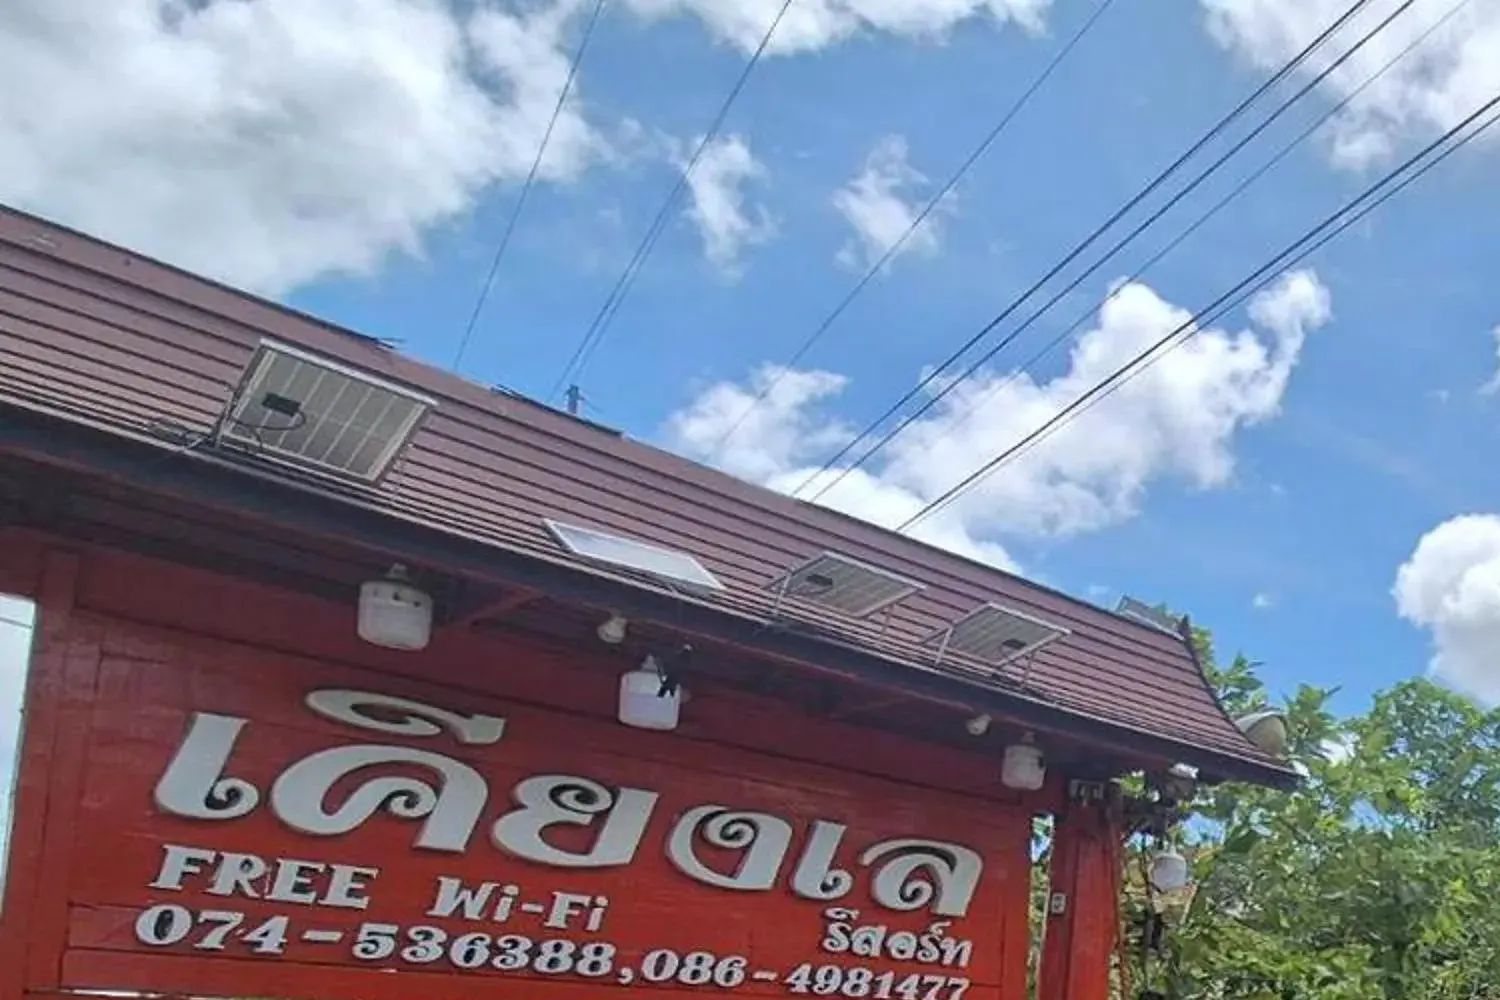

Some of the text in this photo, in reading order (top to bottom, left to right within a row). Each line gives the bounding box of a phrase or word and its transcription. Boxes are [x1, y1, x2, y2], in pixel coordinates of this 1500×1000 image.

[154, 689, 983, 919] เคียงเล
[149, 844, 609, 931] FREE Wi-Fi
[822, 906, 973, 968] รีสอร์ท
